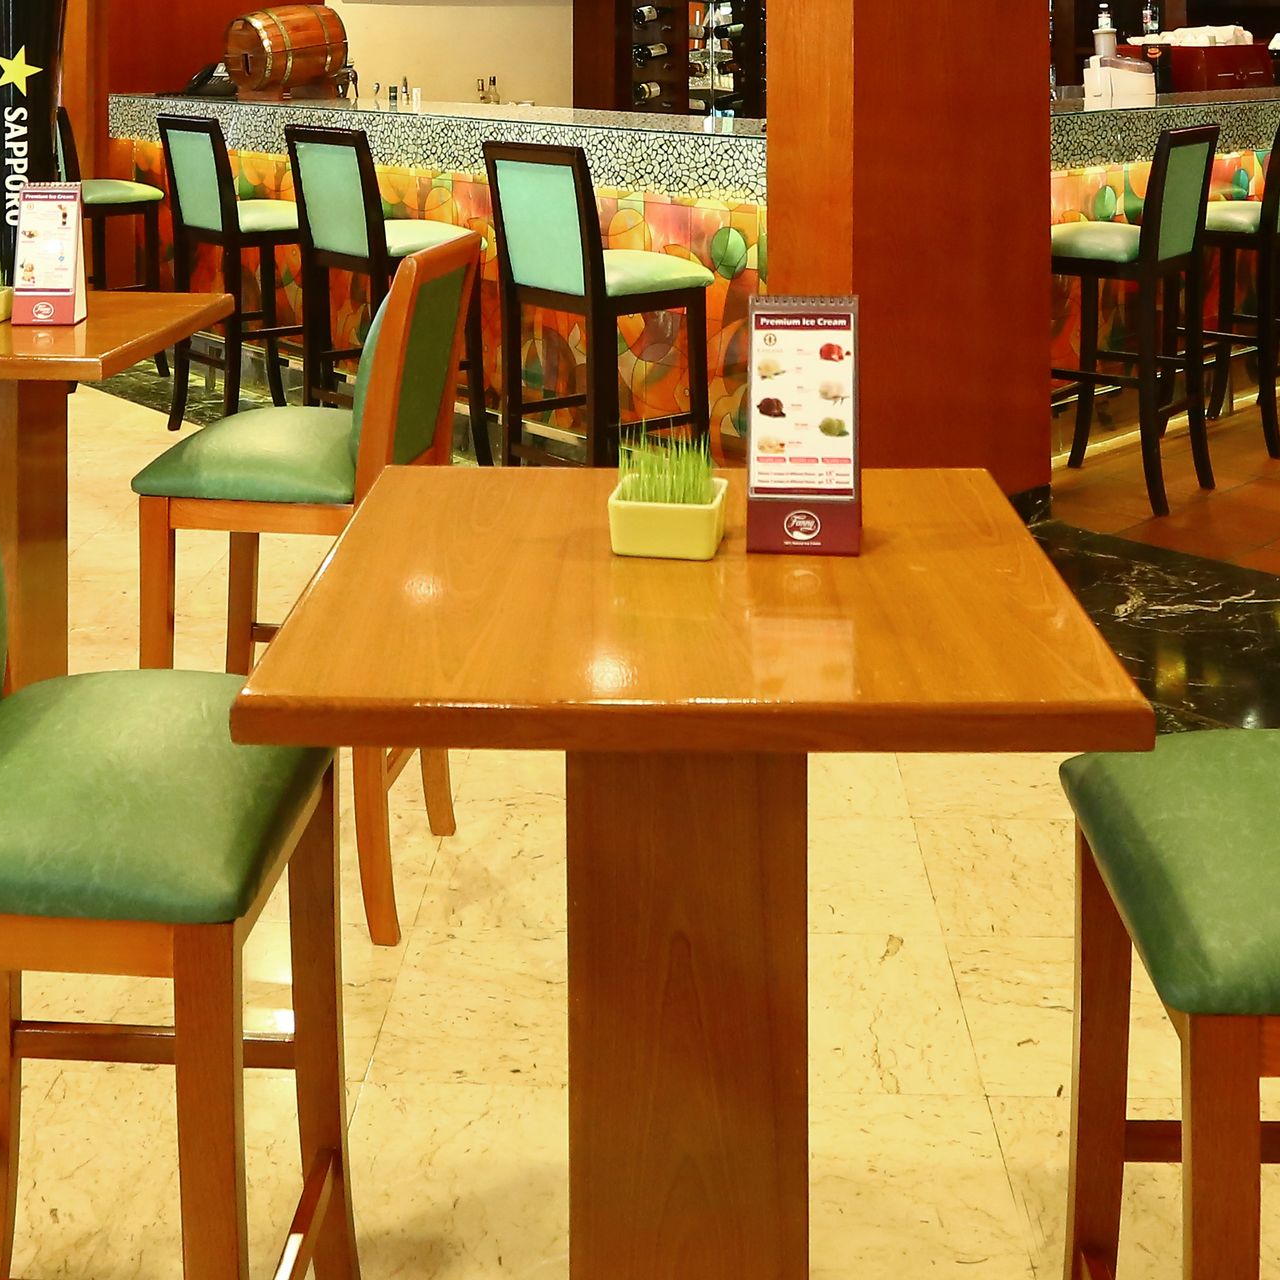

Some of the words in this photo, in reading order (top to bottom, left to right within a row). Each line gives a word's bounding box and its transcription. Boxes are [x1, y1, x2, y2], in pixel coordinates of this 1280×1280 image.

[760, 317, 801, 327] Premium
[802, 317, 816, 327] Ice
[817, 317, 847, 327] Cream
